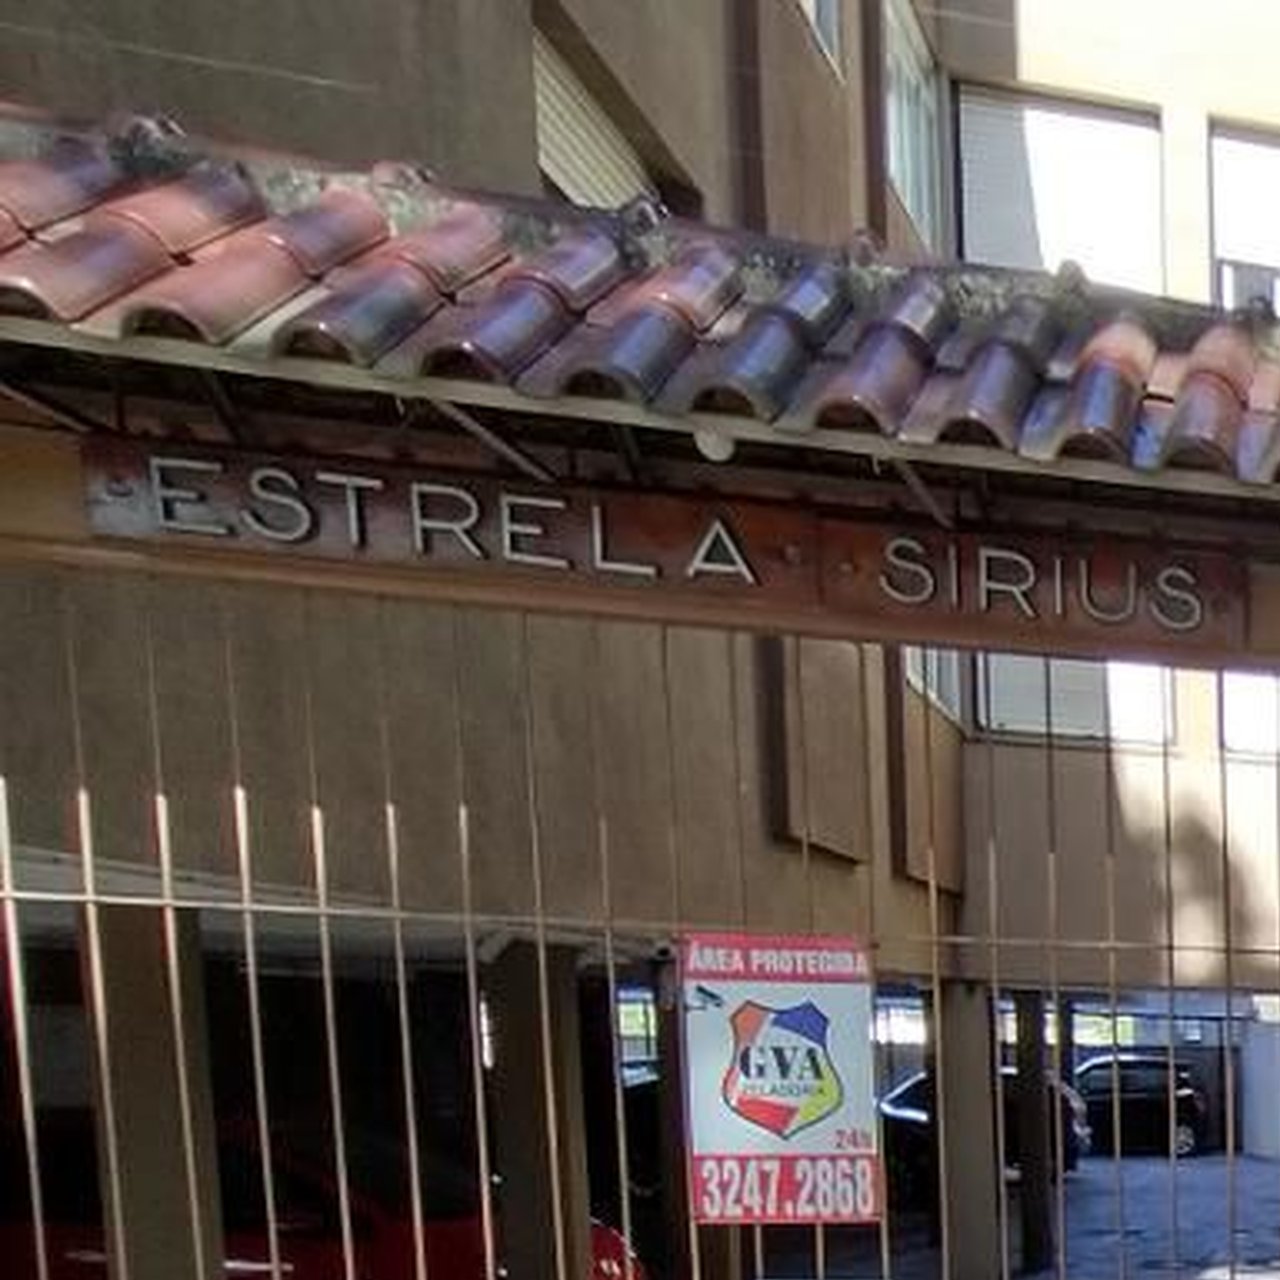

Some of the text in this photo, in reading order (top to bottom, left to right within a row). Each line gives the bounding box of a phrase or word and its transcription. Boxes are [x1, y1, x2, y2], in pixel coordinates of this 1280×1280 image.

[150, 456, 1202, 631] ESTRELA SIRIUS
[740, 1045, 824, 1080] GVA
[702, 1158, 875, 1218] 3247.2868
